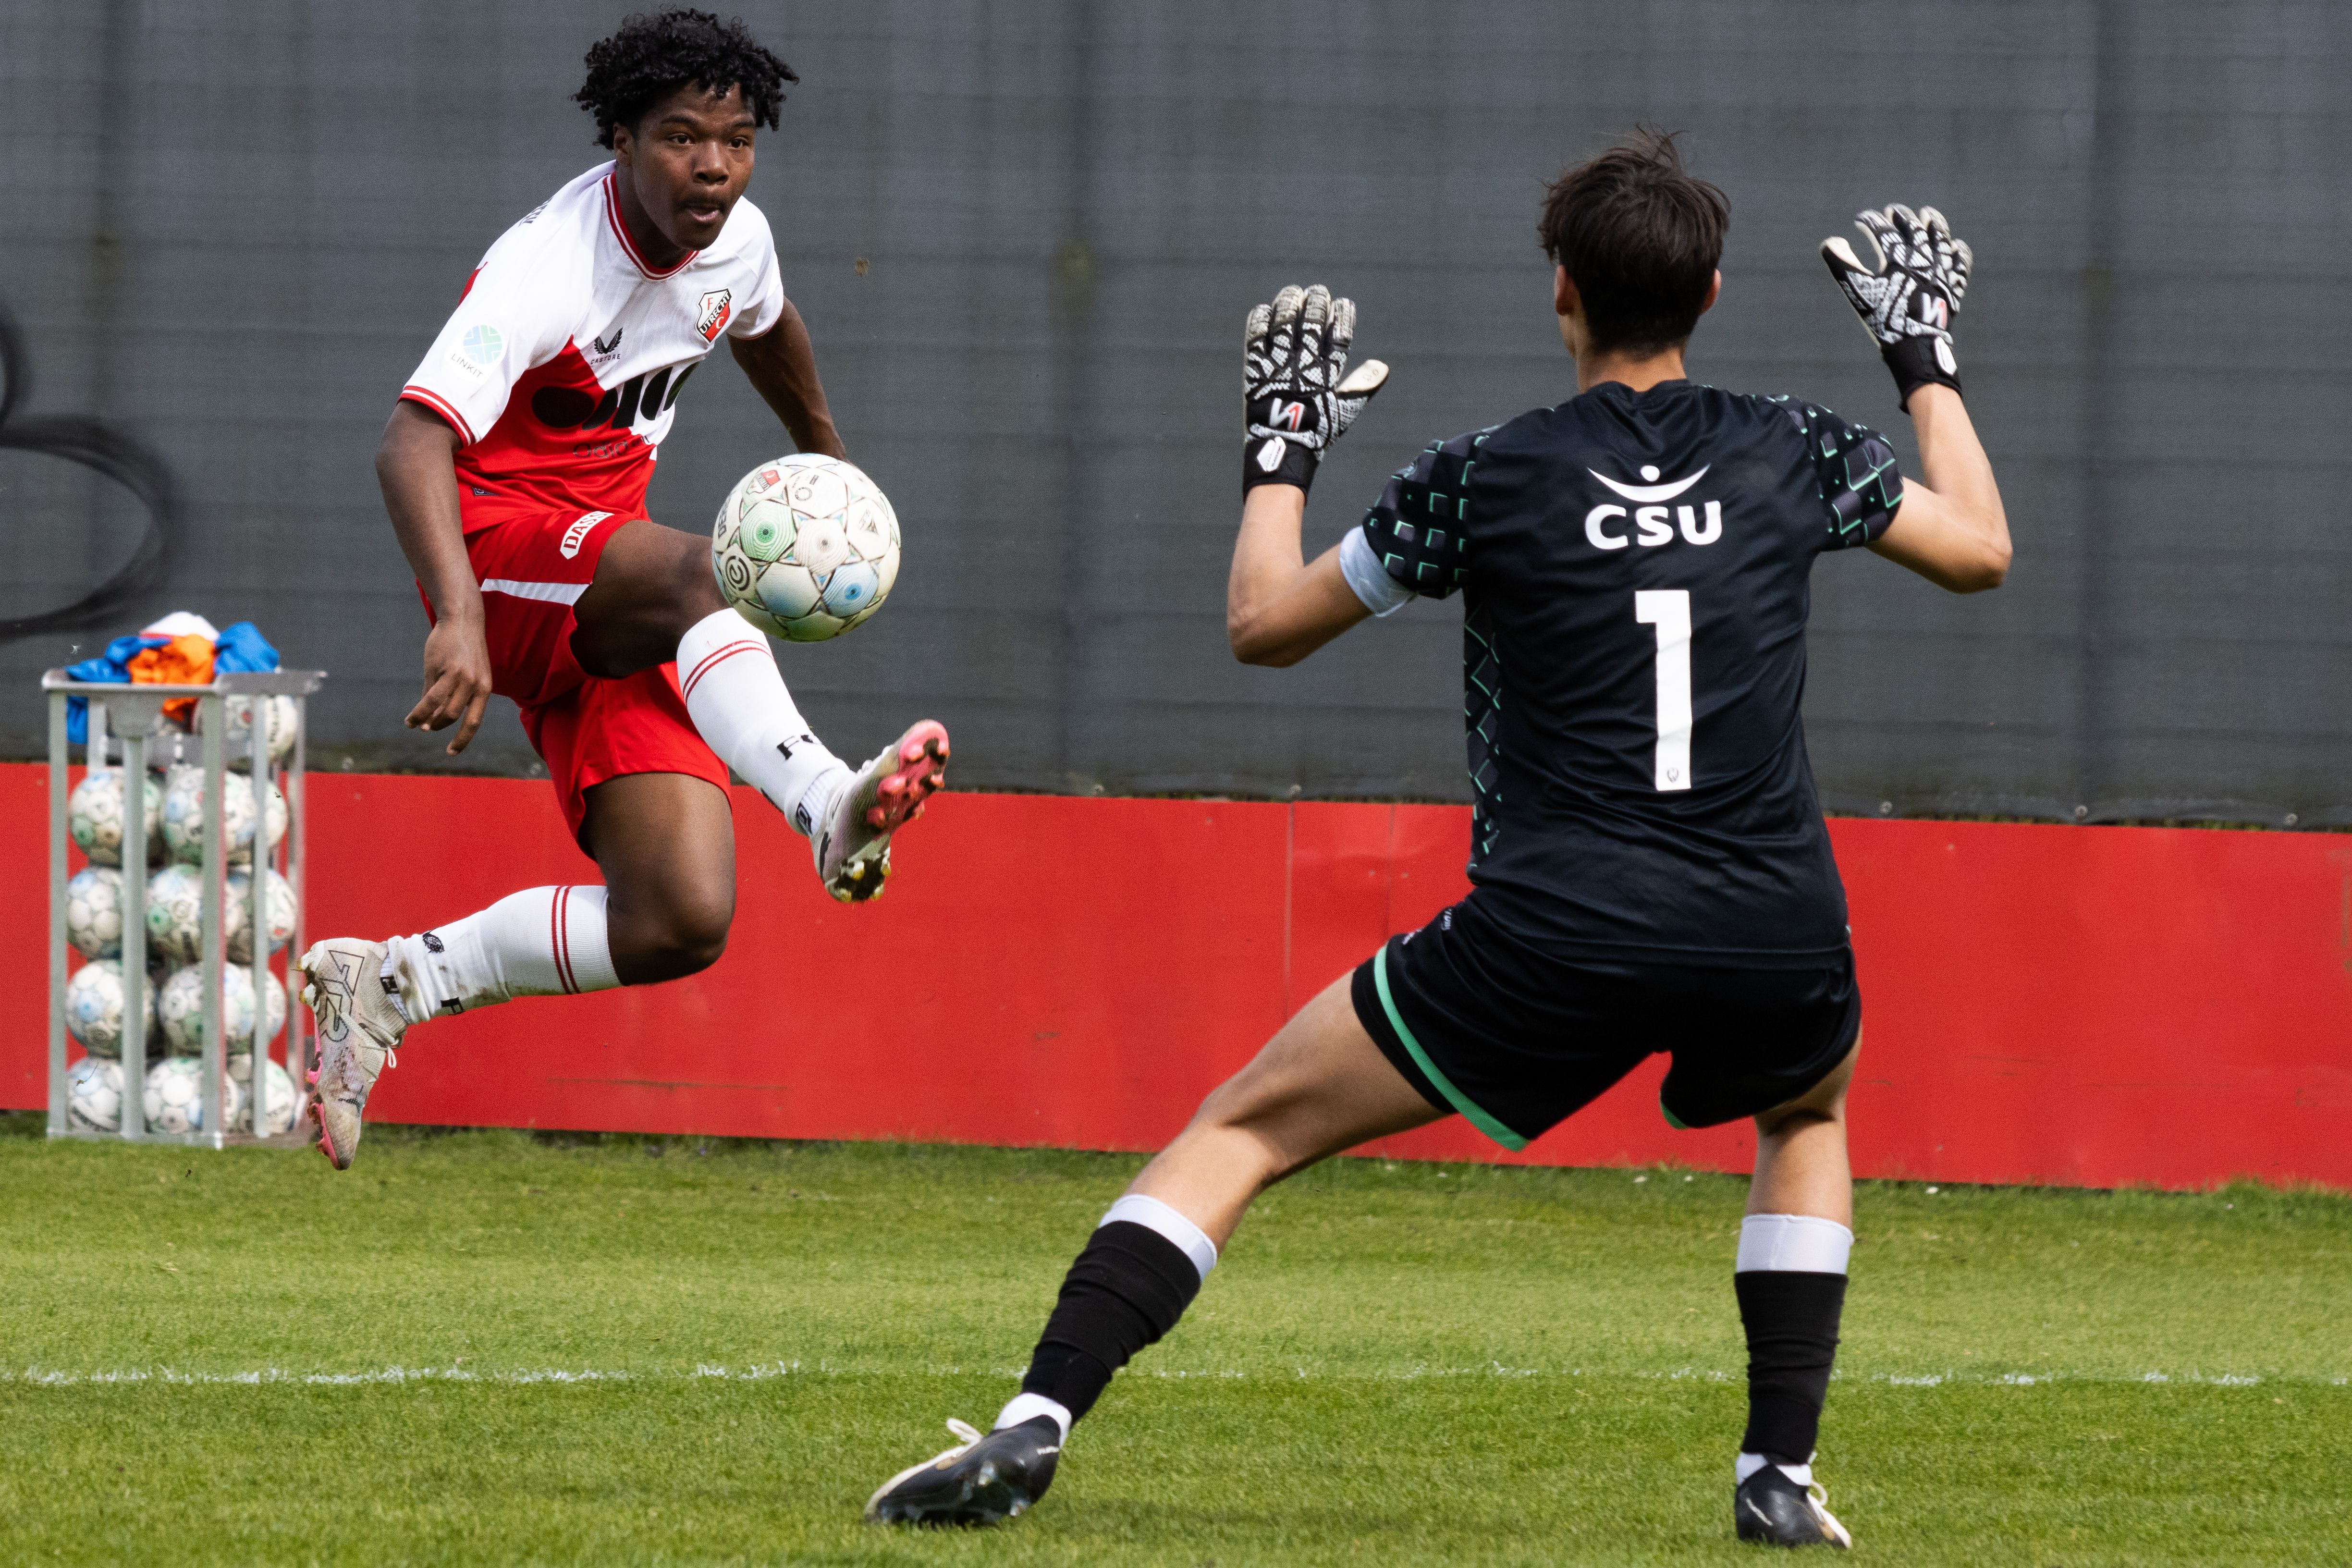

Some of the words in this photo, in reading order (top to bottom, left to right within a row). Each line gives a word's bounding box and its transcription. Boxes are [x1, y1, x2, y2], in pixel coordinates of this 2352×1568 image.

[699, 291, 730, 334] UTRECHT
[451, 353, 483, 378] LINKIT
[590, 353, 621, 365] CASTORE
[1585, 500, 1722, 550] CSU
[1635, 589, 1693, 792] 1
